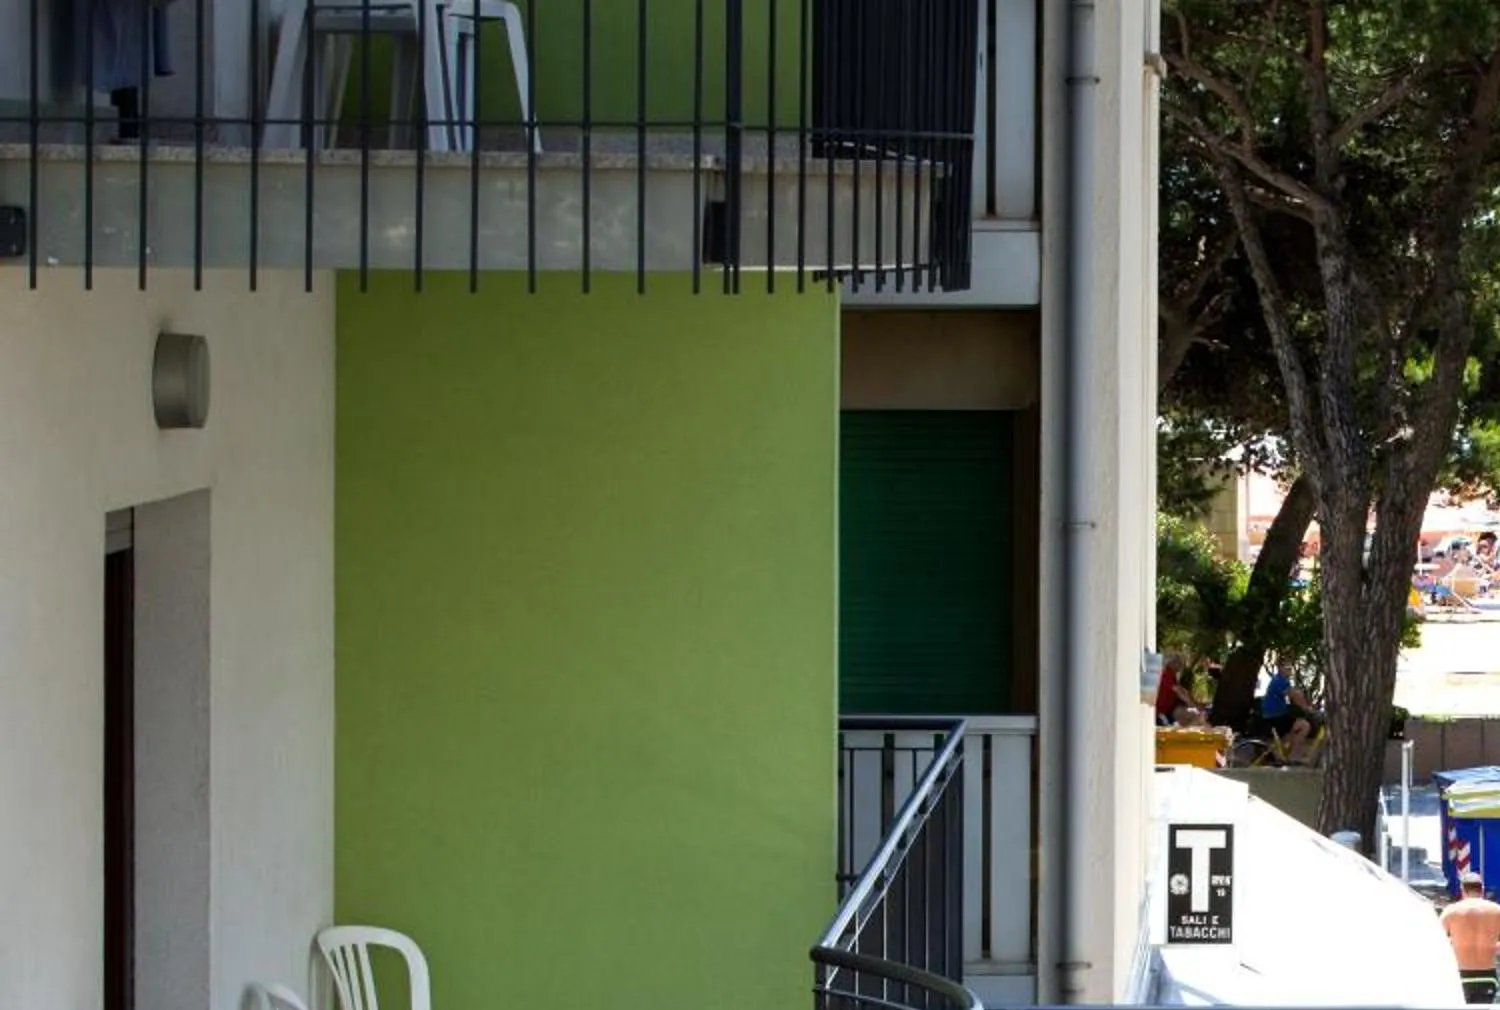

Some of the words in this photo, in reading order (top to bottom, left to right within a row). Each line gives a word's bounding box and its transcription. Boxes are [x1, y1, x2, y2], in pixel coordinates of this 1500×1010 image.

[1175, 830, 1227, 912] T
[1181, 915, 1207, 925] SALI
[1212, 915, 1220, 925] E
[1169, 926, 1231, 939] TABACCHI
